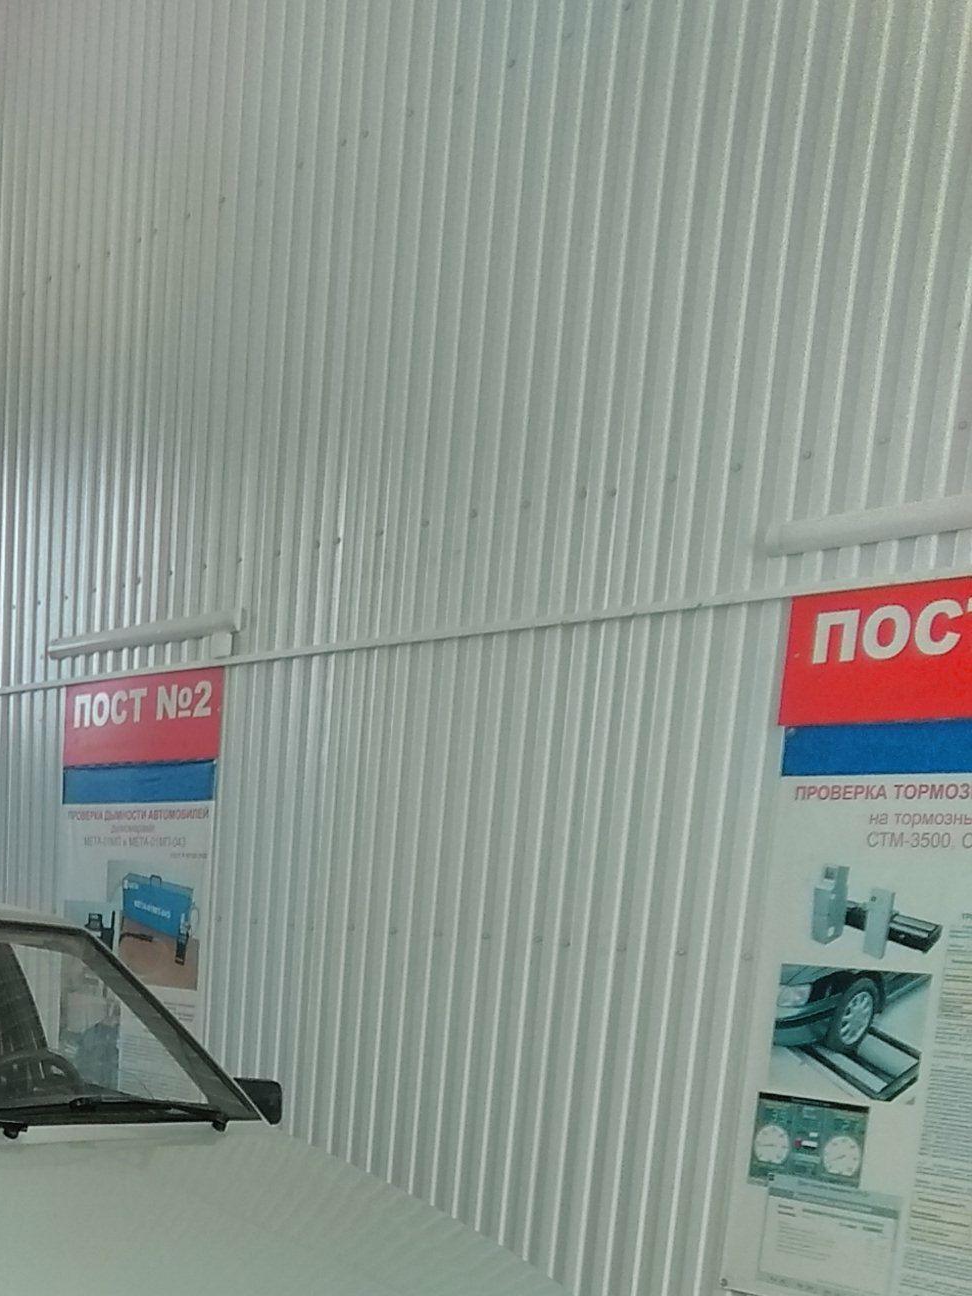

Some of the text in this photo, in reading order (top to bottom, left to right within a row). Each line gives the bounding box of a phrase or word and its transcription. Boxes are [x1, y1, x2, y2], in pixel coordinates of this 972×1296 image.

[811, 596, 972, 665] ПОС
[73, 680, 213, 729] ПОСТ №2
[794, 784, 888, 801] ПРОВЕРКА
[868, 813, 888, 825] на
